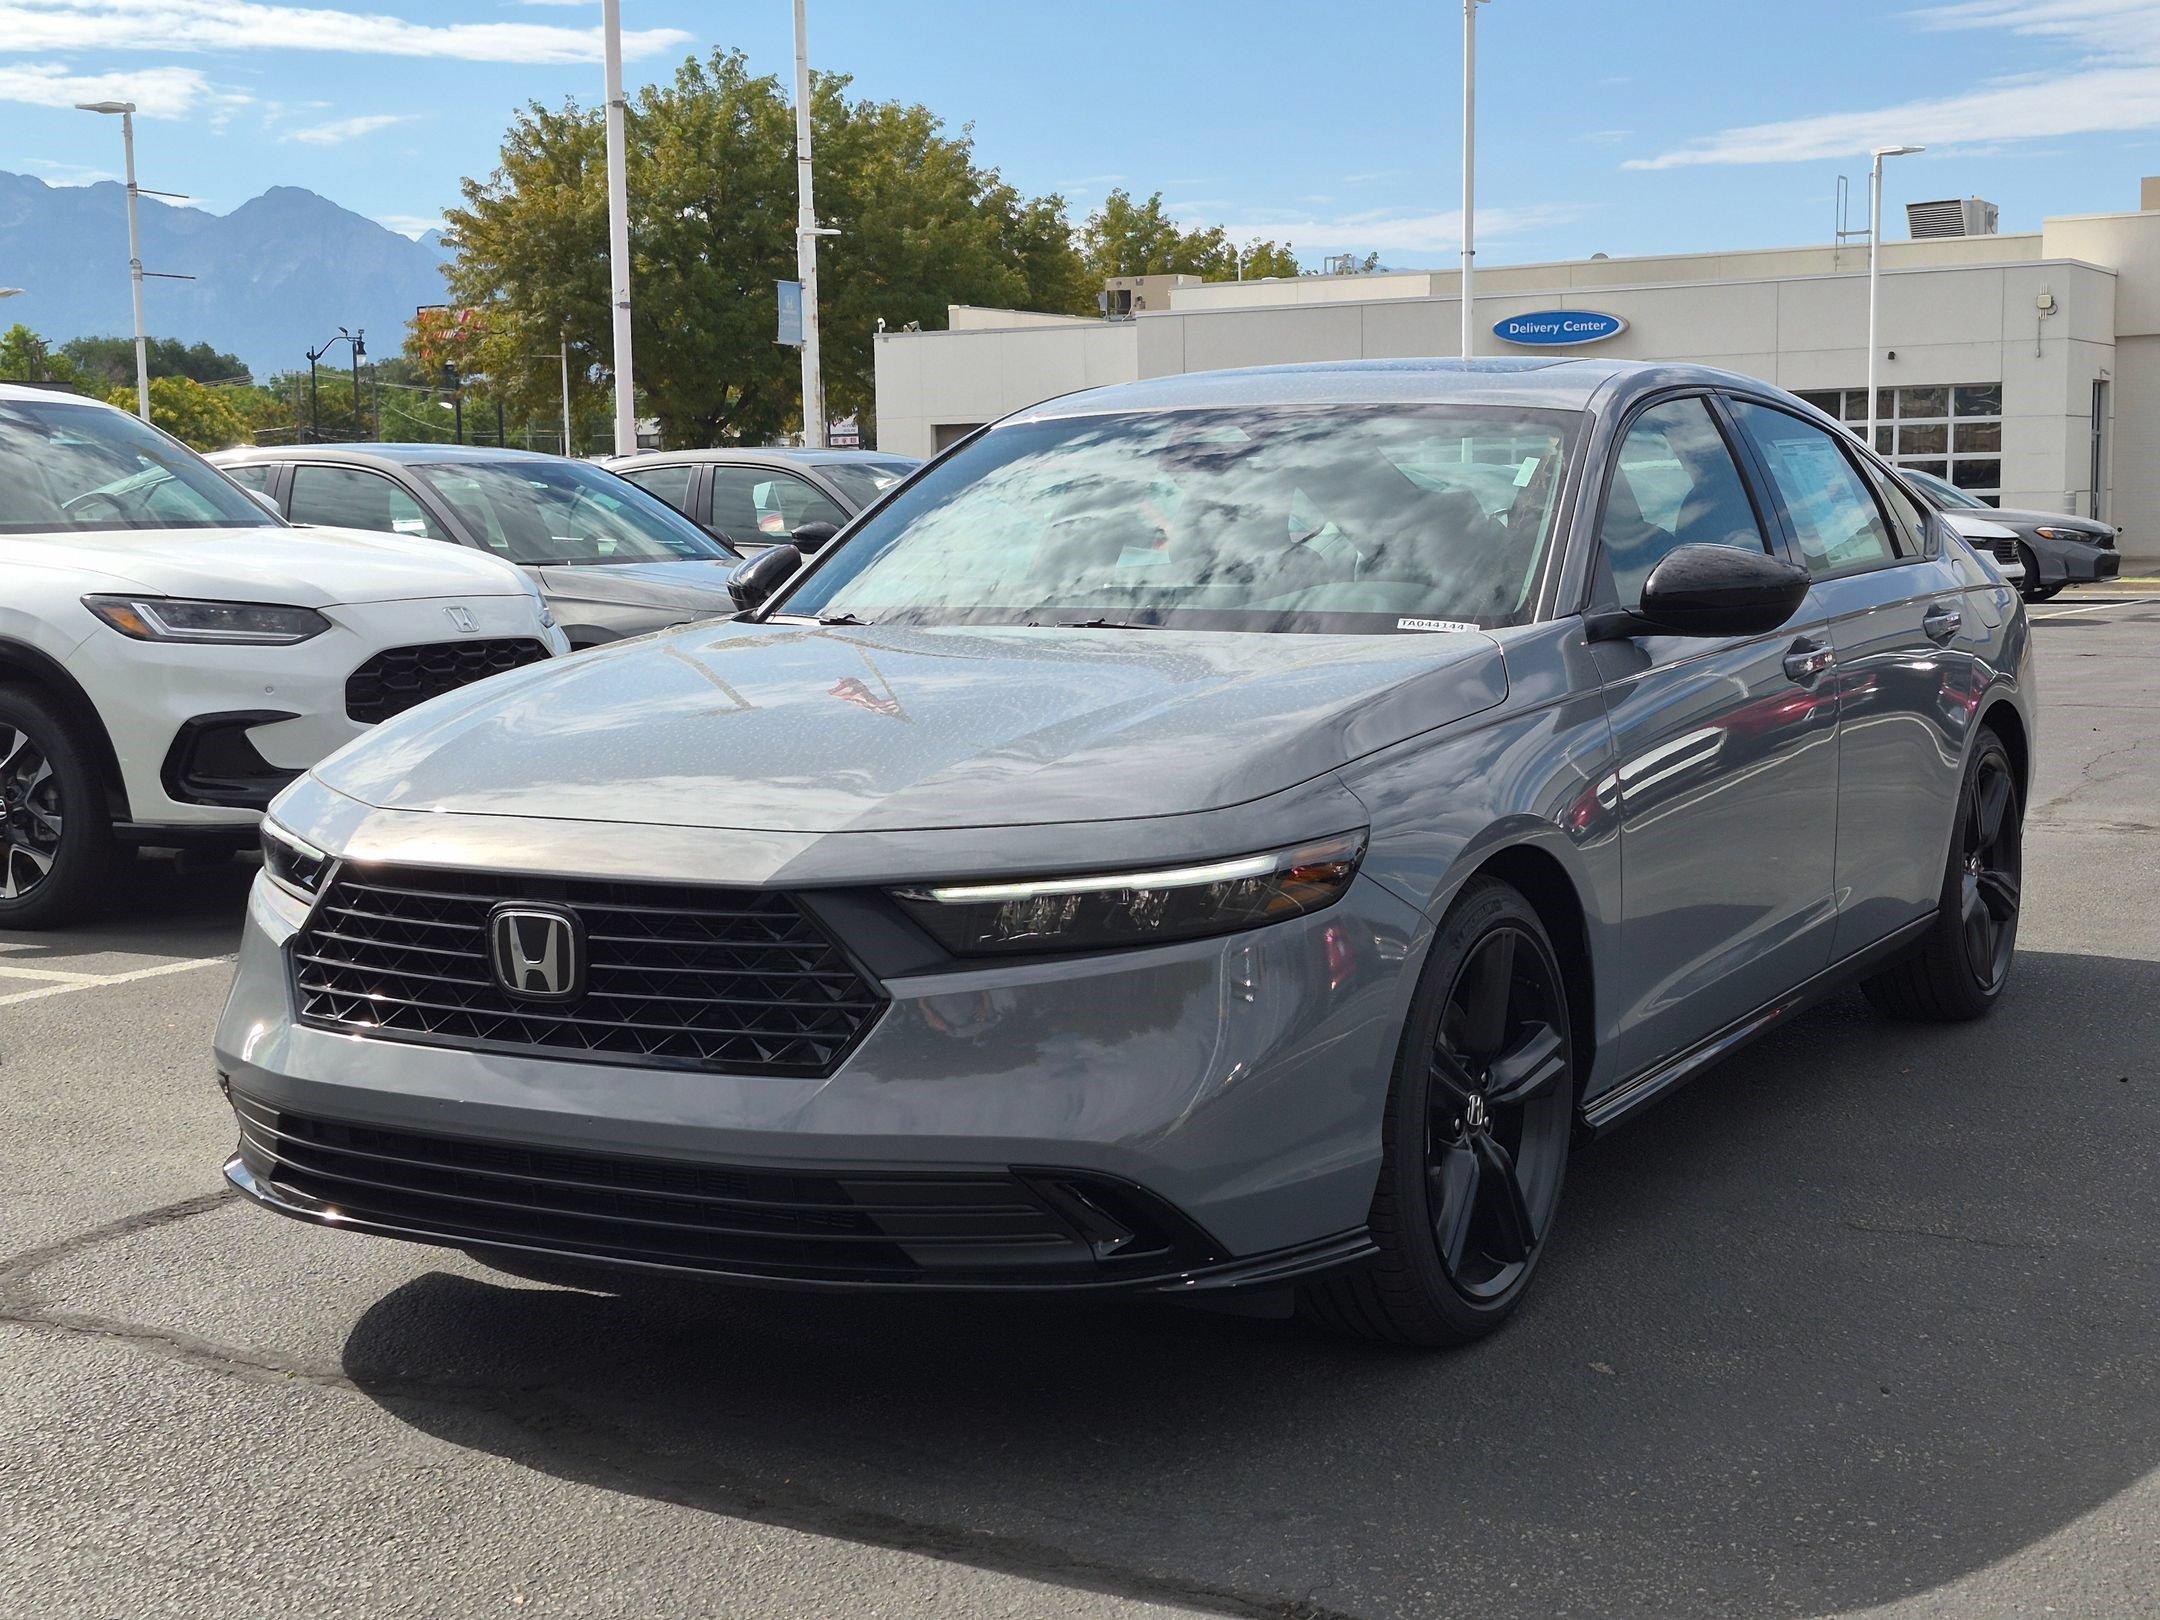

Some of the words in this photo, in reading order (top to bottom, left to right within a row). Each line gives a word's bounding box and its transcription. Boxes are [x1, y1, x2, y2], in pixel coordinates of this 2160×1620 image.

[1509, 322, 1560, 335] Delivery
[1563, 320, 1607, 332] Center
[1401, 619, 1465, 631] TA044144
